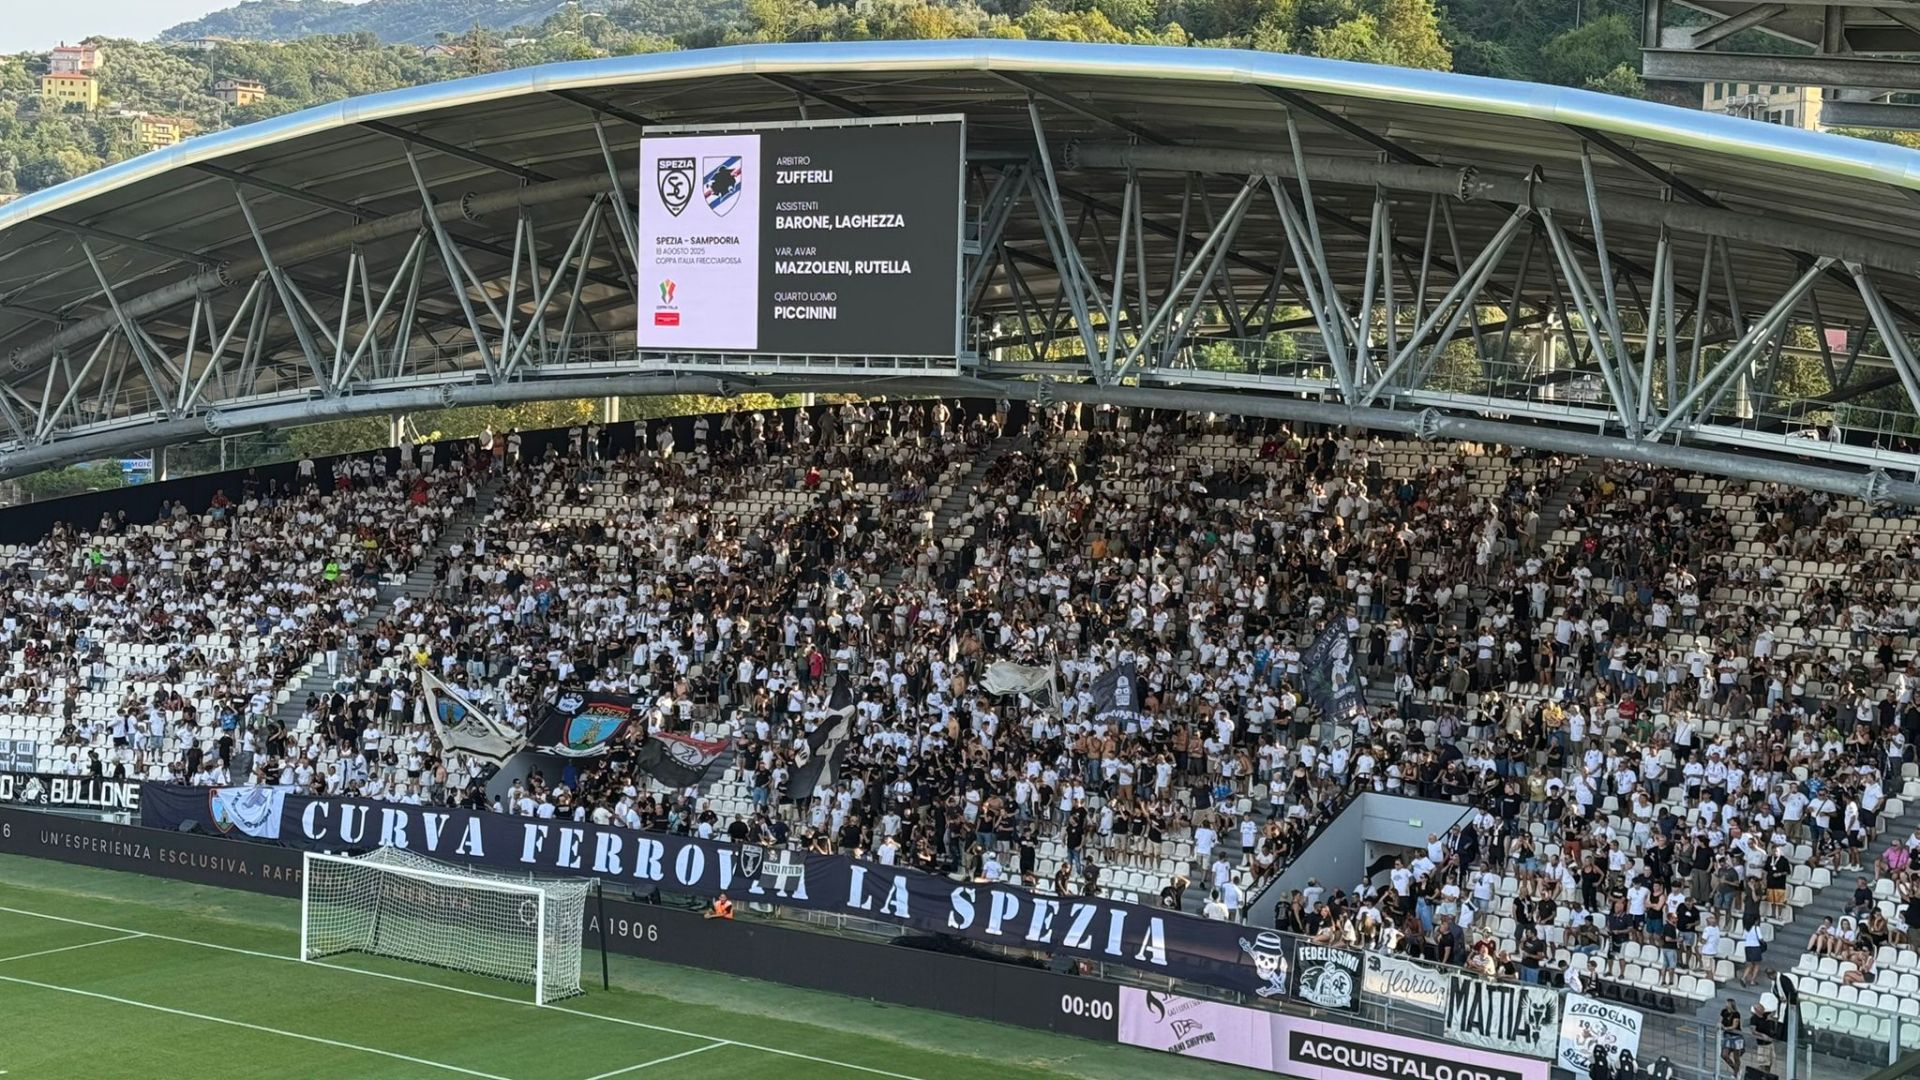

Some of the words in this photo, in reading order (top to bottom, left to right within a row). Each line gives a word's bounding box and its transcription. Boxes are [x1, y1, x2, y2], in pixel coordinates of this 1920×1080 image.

[659, 160, 694, 169] SPEZIA
[776, 156, 811, 166] ARBITRO
[776, 170, 833, 185] ZUFFERLI
[776, 202, 819, 212] ASSISTENTI
[776, 215, 833, 231] BARONE,
[835, 214, 905, 229] LAGHEZZA
[656, 236, 683, 245] SPEZIA
[690, 236, 740, 245] SAMPDORIA
[663, 247, 689, 256] AGOSTO
[690, 247, 706, 256] 2025
[775, 247, 793, 257] VAR,
[794, 247, 817, 256] AVAR
[656, 257, 677, 265] COPPA
[677, 257, 695, 265] ITALIA
[696, 257, 742, 265] FRECCIAROSSA
[775, 261, 852, 276] MAZZOLENI,
[855, 261, 911, 275] RUTELLA
[775, 292, 809, 302] QUARTO
[810, 292, 837, 301] UOMO
[774, 306, 837, 320] PICCININI
[51, 778, 140, 809] BULLONE
[41, 830, 151, 860] UN'ESPERIENZA
[159, 848, 254, 875] ESCLUSIVA.
[609, 917, 658, 942] 1906
[302, 801, 485, 857] CURVA
[521, 823, 809, 900] FERROVA
[847, 865, 911, 918] LA
[948, 886, 1168, 966] SPEZIA
[1299, 946, 1360, 972] FEDELISSIMI
[1380, 968, 1439, 995] Ilaria
[1061, 994, 1114, 1021] 00:00
[1447, 975, 1531, 1044] MATTIA
[1571, 1003, 1636, 1030] ORGOGLIO
[1185, 1032, 1217, 1049] SHIPPING
[1299, 1040, 1453, 1080] ACQUISTALO
